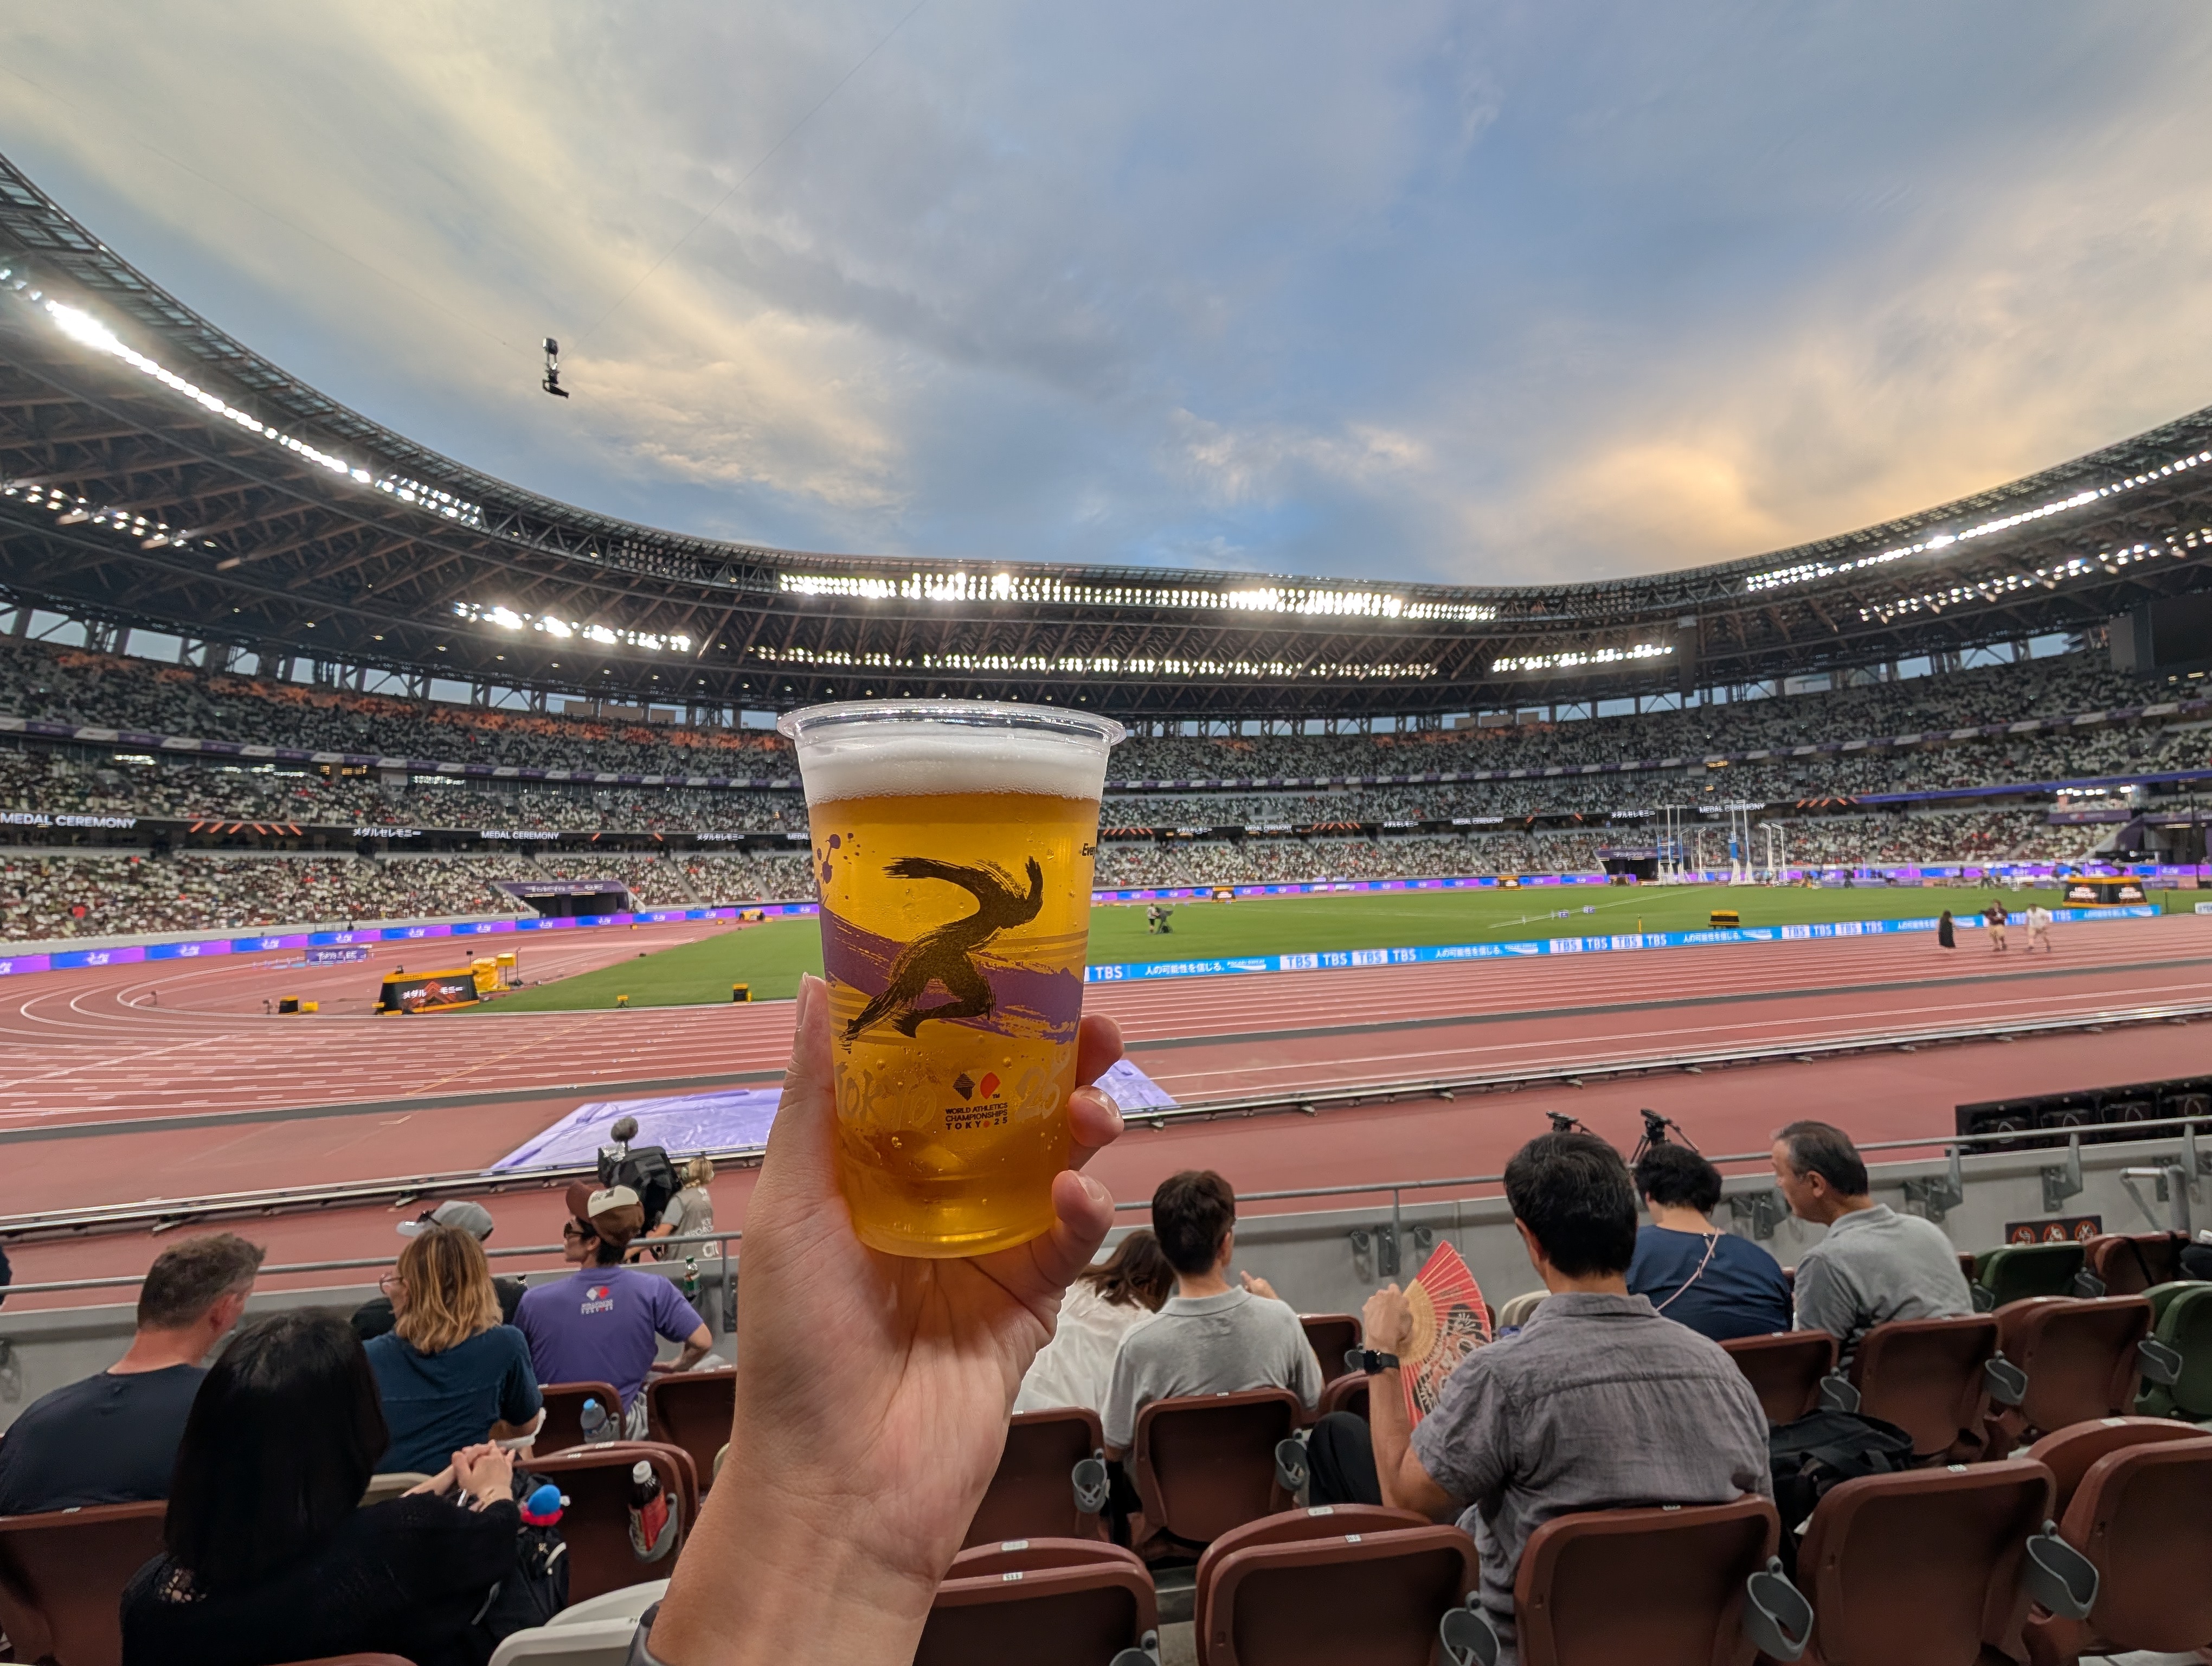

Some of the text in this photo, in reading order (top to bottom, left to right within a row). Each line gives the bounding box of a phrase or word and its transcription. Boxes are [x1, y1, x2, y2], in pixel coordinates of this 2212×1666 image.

[1699, 805, 1723, 813] MEDAL
[0, 812, 136, 829] MEDAL CEREMONY
[1472, 817, 1504, 825] CEREMONY
[353, 828, 421, 837] メダルセレモニー
[481, 830, 559, 840] MEDAL CEREMONY
[1556, 933, 1667, 952] TBS TBS TBS TBS
[1287, 947, 1417, 969] TBS TBS TBS TBS
[1095, 966, 1123, 979] TBS
[402, 989, 427, 999] メダル
[972, 1102, 1008, 1113] ATHLETICS
[946, 1109, 1008, 1122] CHAMPIONSHIPS
